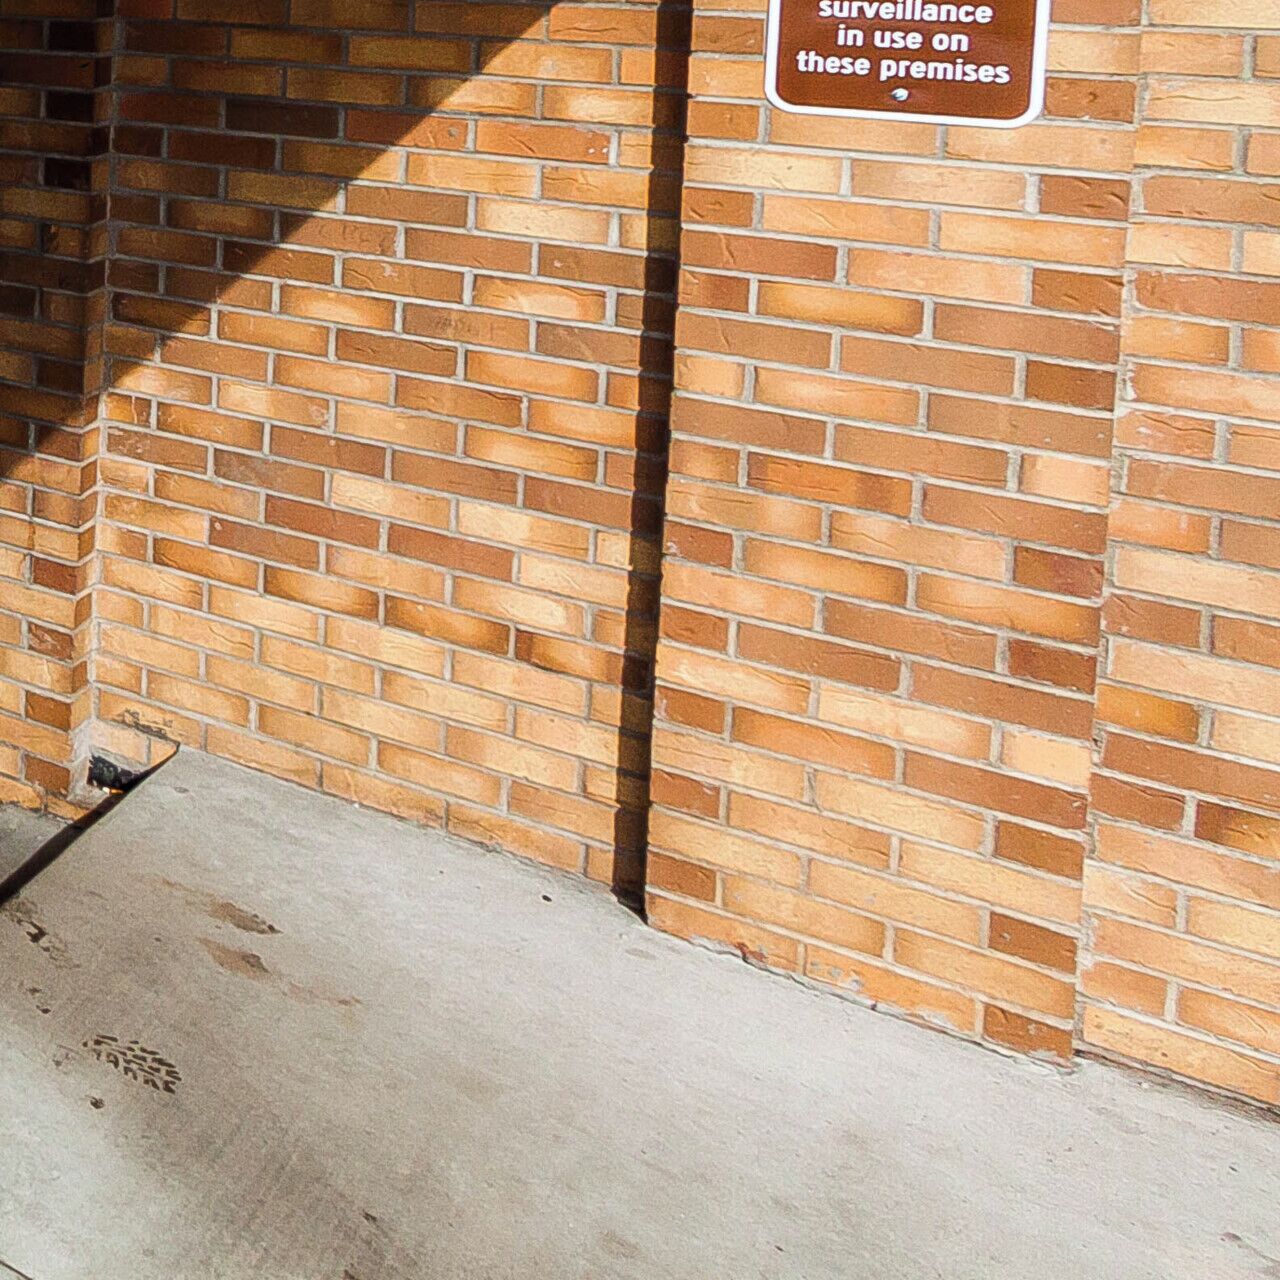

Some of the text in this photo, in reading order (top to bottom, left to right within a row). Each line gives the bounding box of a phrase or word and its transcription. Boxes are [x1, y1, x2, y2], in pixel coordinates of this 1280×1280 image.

[837, 24, 970, 52] in use on
[796, 50, 1011, 84] these premises
